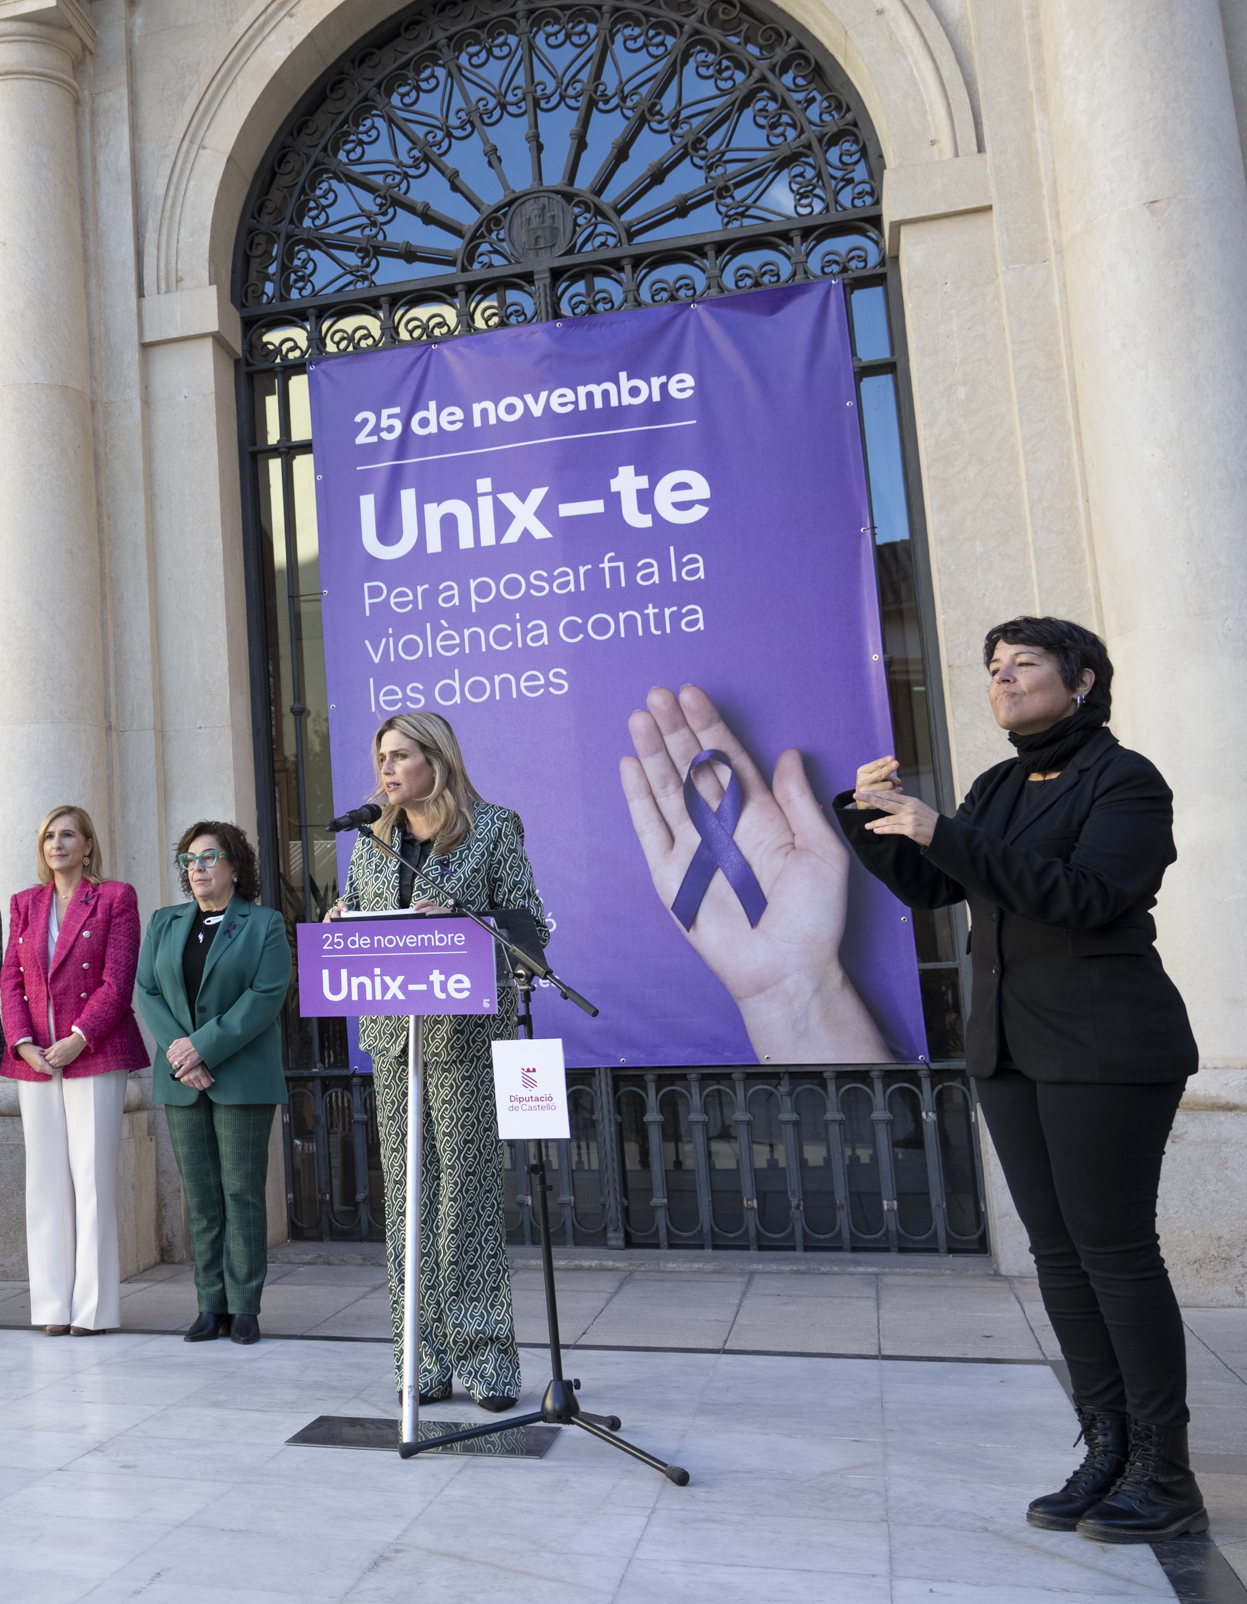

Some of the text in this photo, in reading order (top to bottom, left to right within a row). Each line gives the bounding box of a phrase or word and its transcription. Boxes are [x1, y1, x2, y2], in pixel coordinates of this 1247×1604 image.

[354, 371, 695, 445] 25 de novembre
[359, 465, 711, 560] Unix-te
[363, 546, 705, 616] Per a posar fi a la
[364, 602, 704, 663] violència contra
[369, 666, 569, 712] les dones
[322, 930, 465, 949] 25 de novembre
[322, 968, 471, 1001] Unix-te
